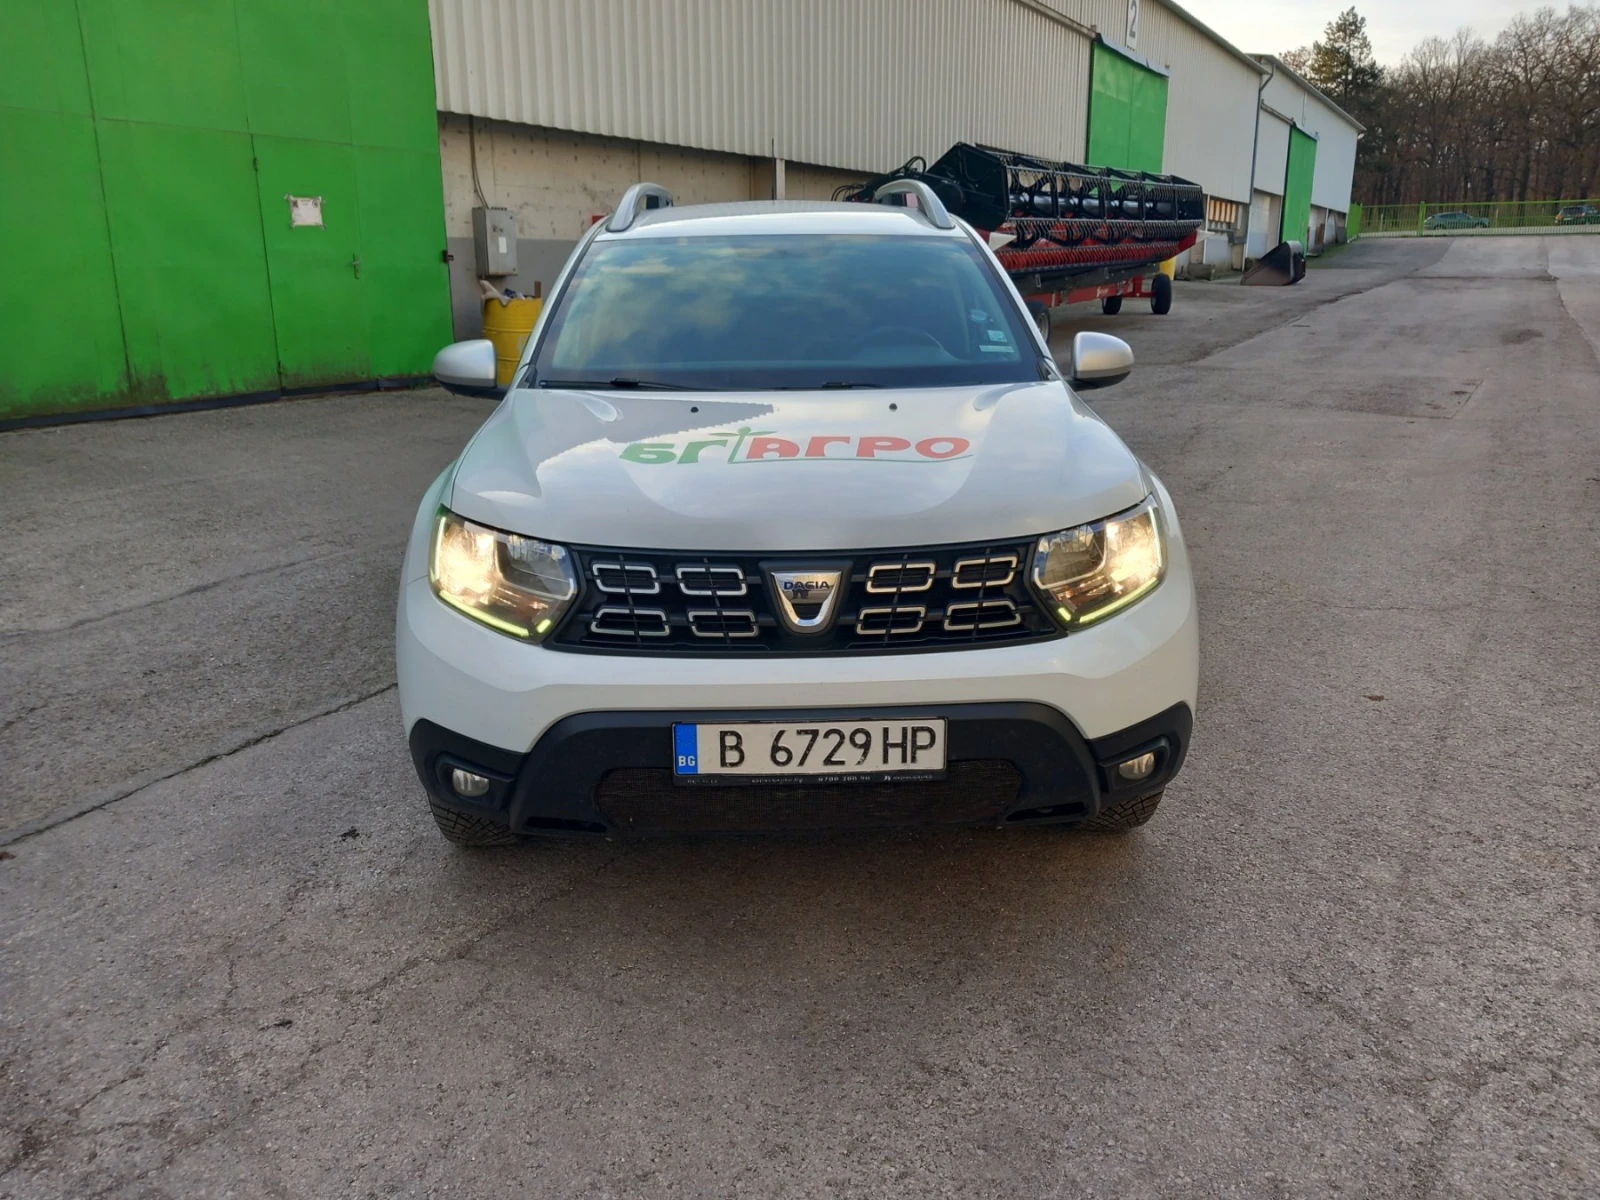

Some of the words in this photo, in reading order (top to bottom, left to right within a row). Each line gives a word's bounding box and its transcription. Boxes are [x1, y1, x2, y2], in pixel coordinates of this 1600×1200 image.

[1129, 0, 1137, 38] 2
[783, 581, 830, 590] DACIA
[719, 730, 745, 768] B
[770, 728, 872, 768] 6729
[882, 726, 937, 765] HP
[678, 755, 696, 767] BG
